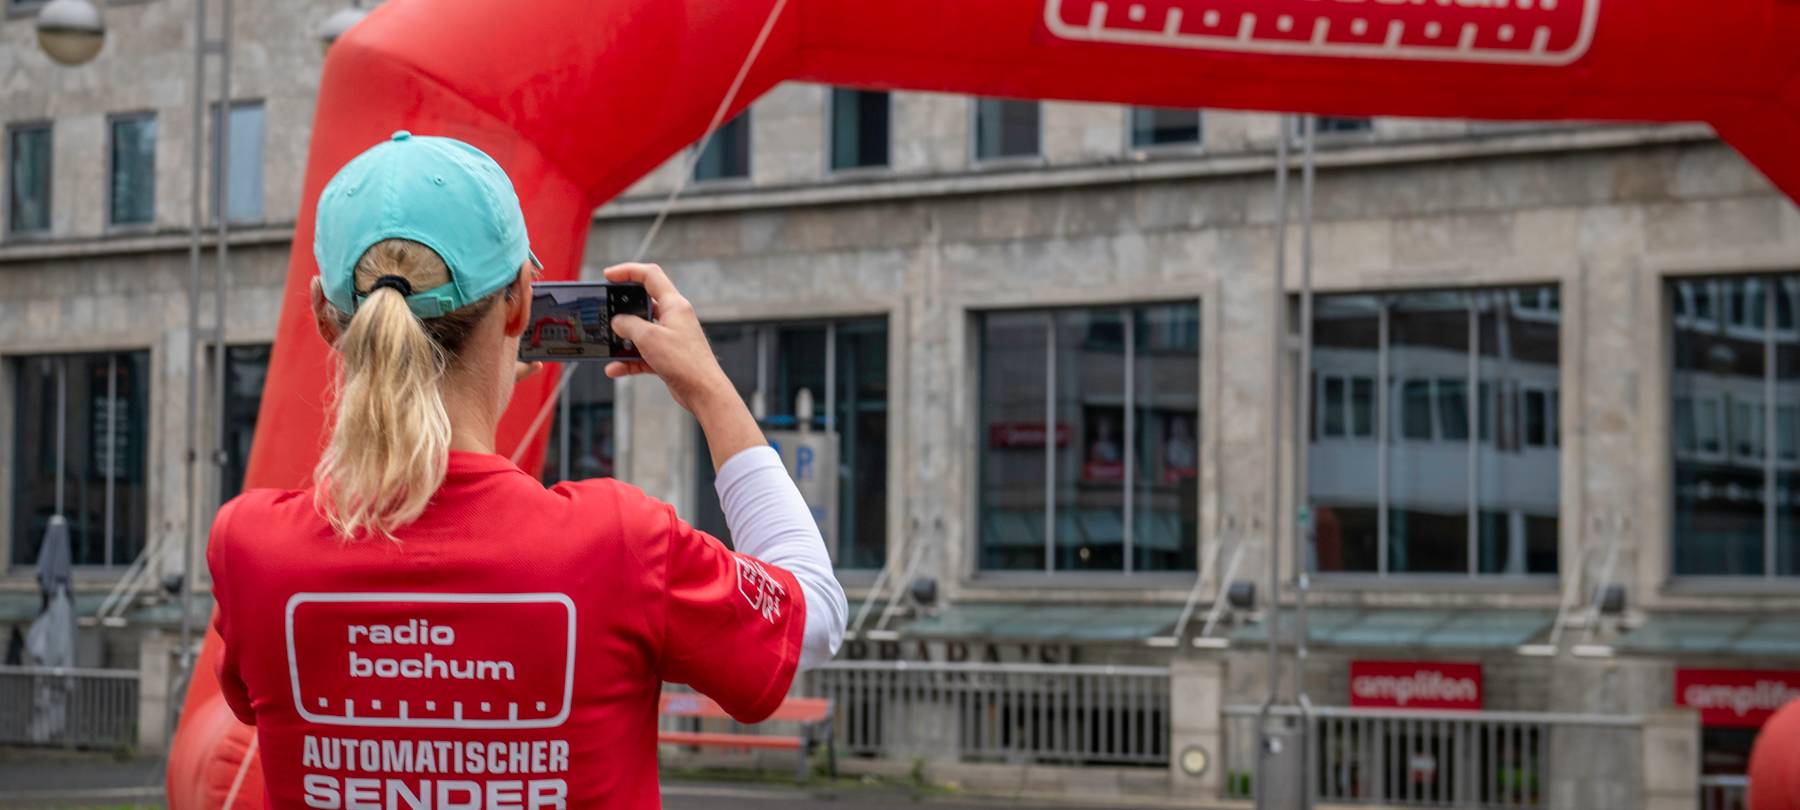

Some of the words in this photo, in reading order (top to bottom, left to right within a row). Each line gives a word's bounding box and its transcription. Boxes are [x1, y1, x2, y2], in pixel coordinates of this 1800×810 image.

[348, 619, 455, 646] radio
[349, 651, 515, 680] bochum
[1353, 670, 1477, 704] amplifon
[303, 735, 570, 774] AUTOMATISCHER
[303, 774, 569, 810] SENDER
